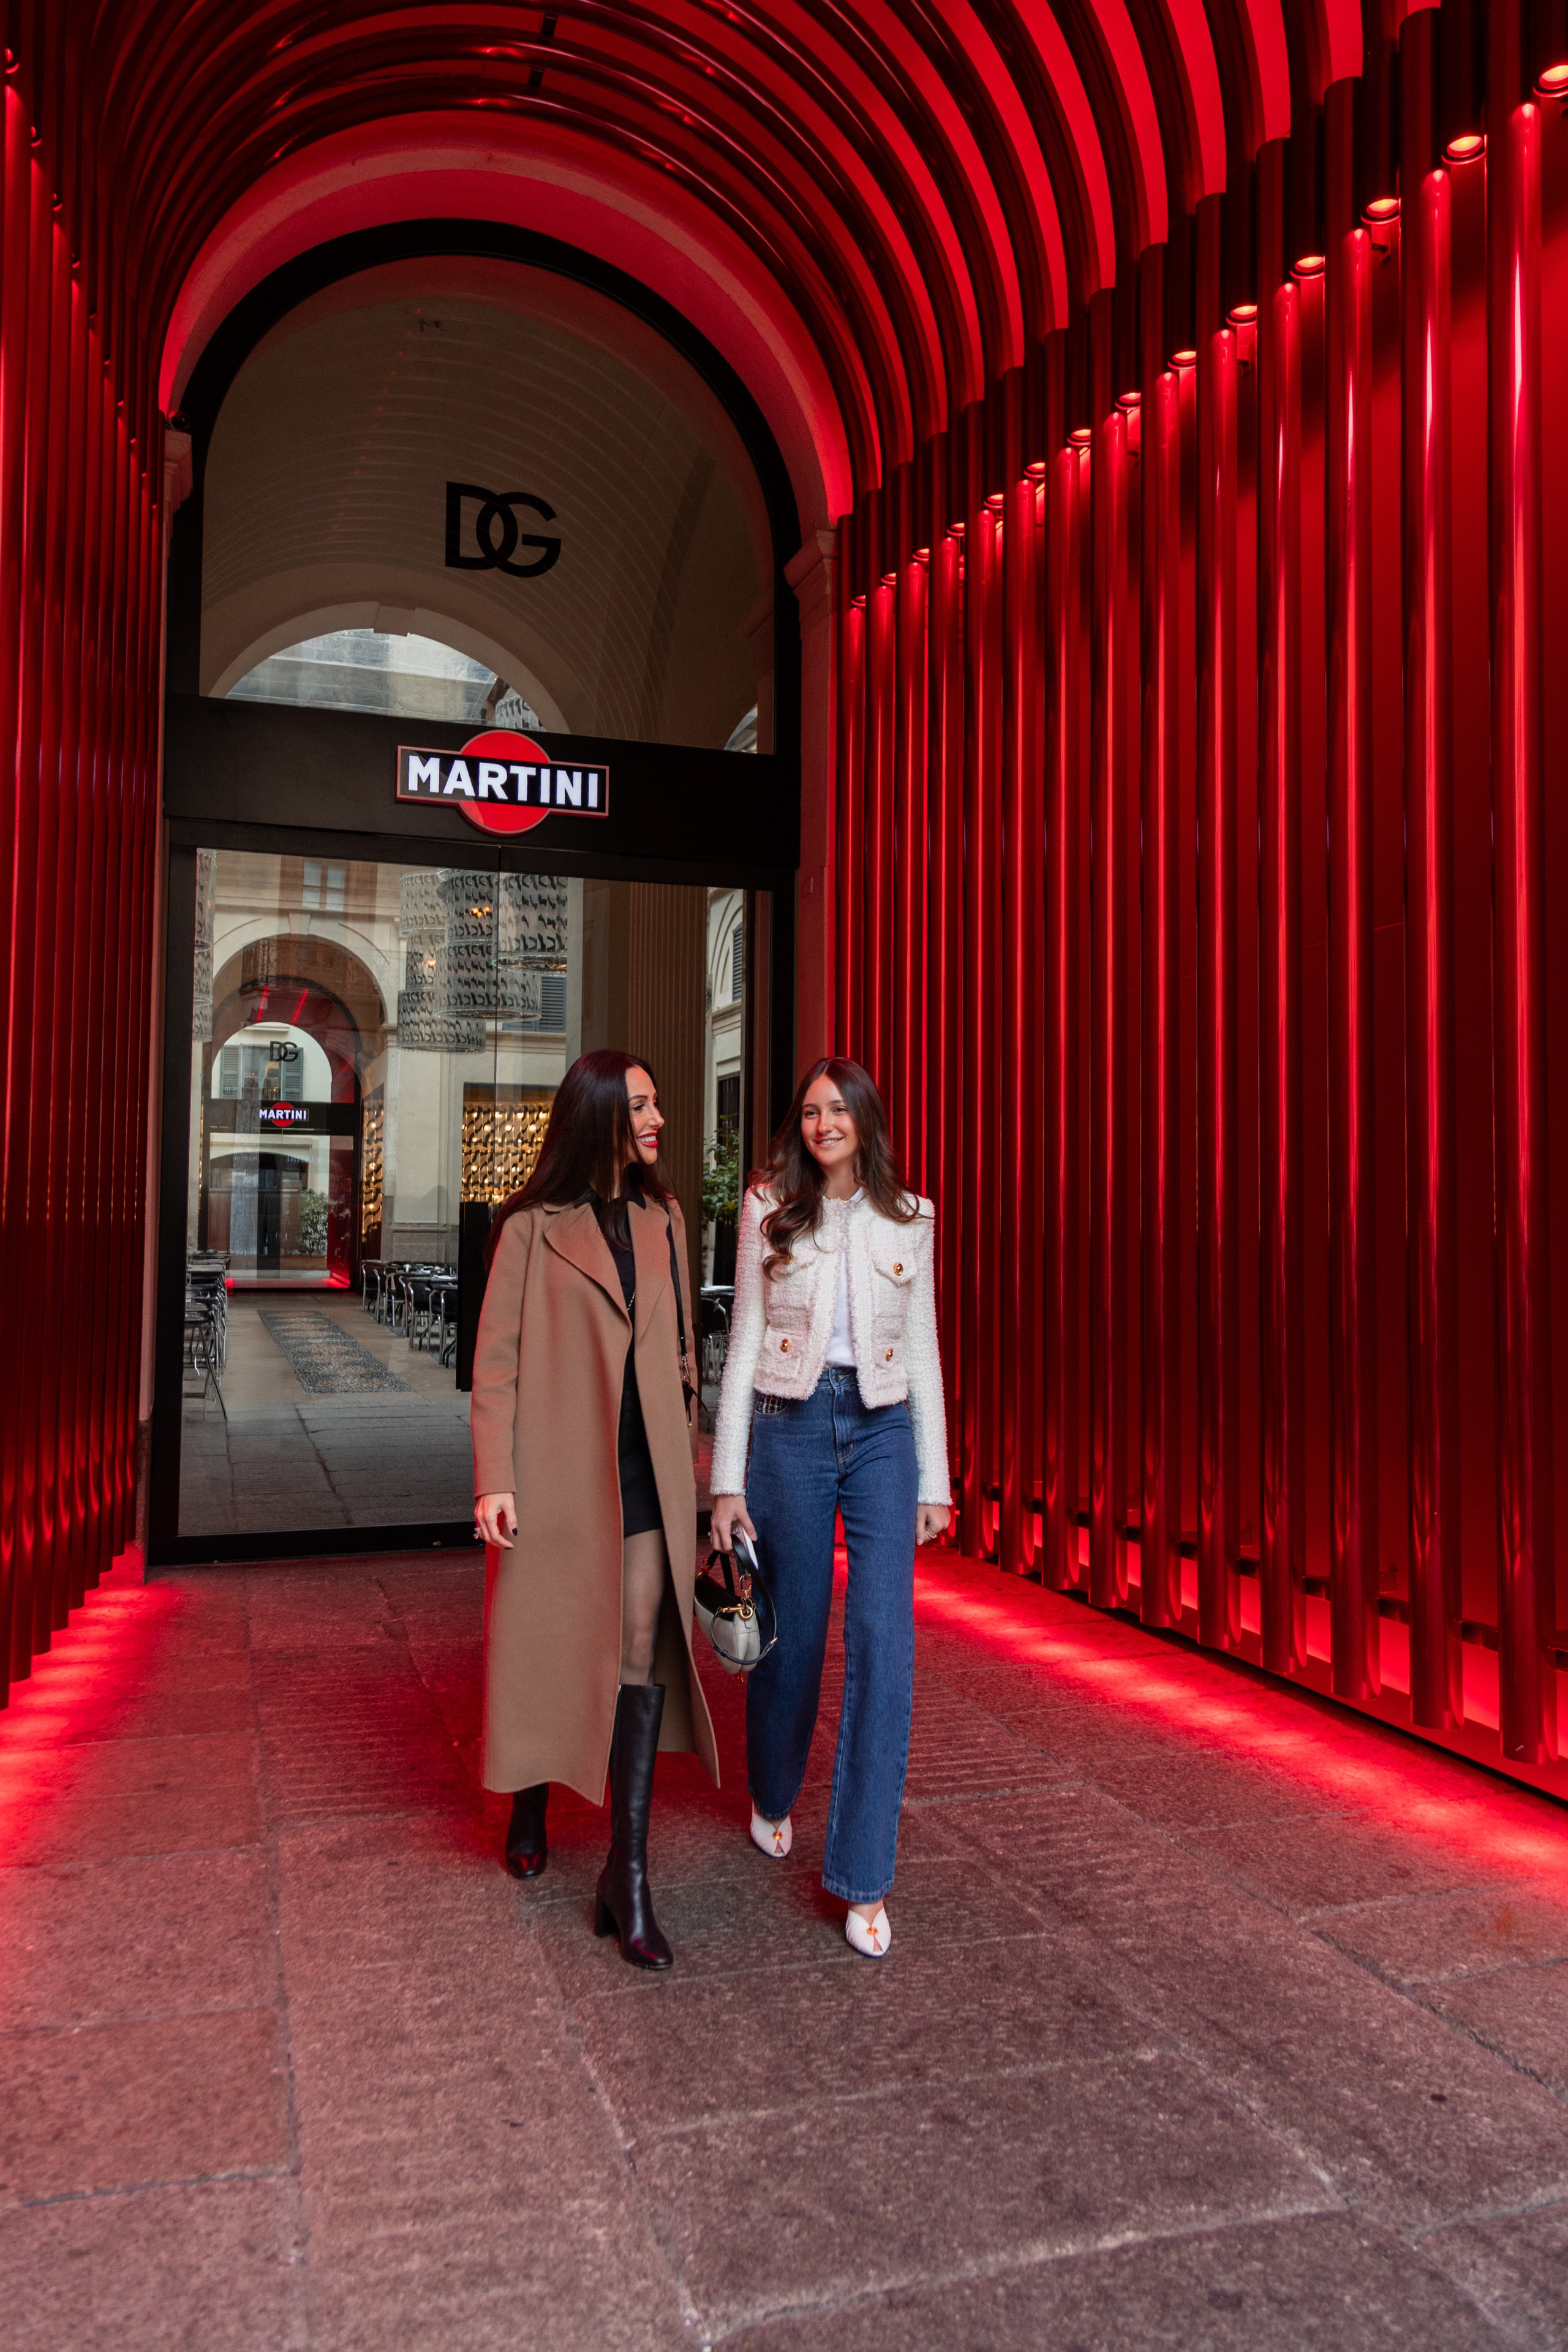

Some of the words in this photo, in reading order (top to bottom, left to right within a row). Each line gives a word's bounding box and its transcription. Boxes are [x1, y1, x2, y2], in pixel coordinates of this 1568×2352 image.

[445, 481, 561, 578] DG
[408, 755, 598, 807] MARTINI
[270, 1041, 299, 1062] DG
[259, 1109, 306, 1120] MARTINI
